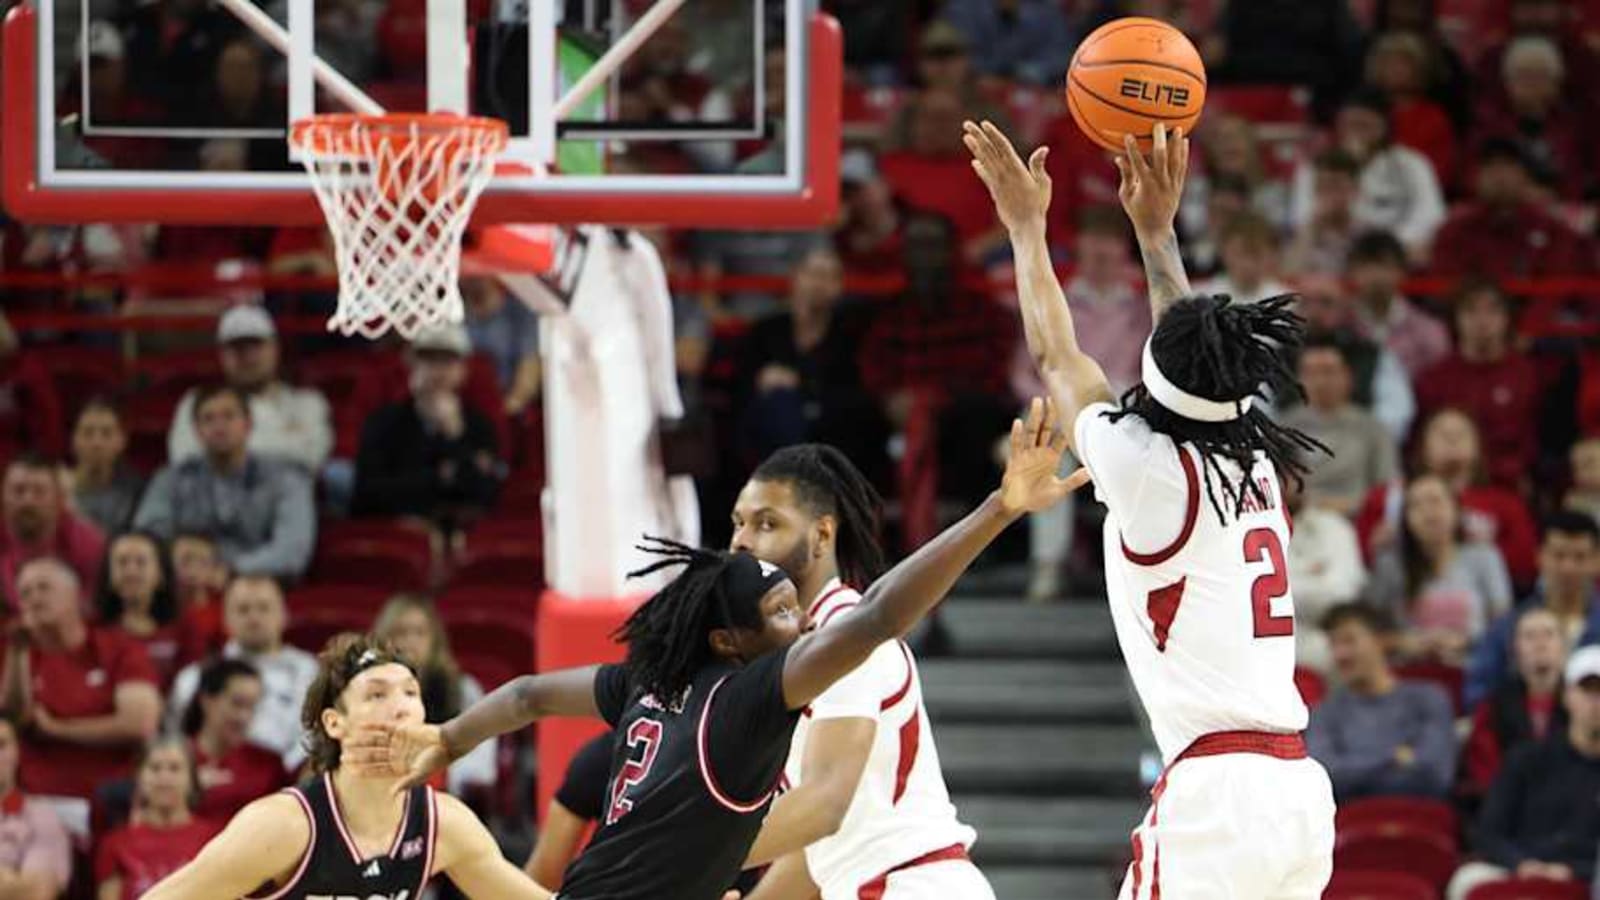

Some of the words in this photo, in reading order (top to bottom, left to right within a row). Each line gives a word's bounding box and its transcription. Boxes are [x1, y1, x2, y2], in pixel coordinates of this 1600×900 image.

[1121, 78, 1189, 107] ELITE
[1243, 527, 1294, 638] 2
[606, 716, 663, 826] 2
